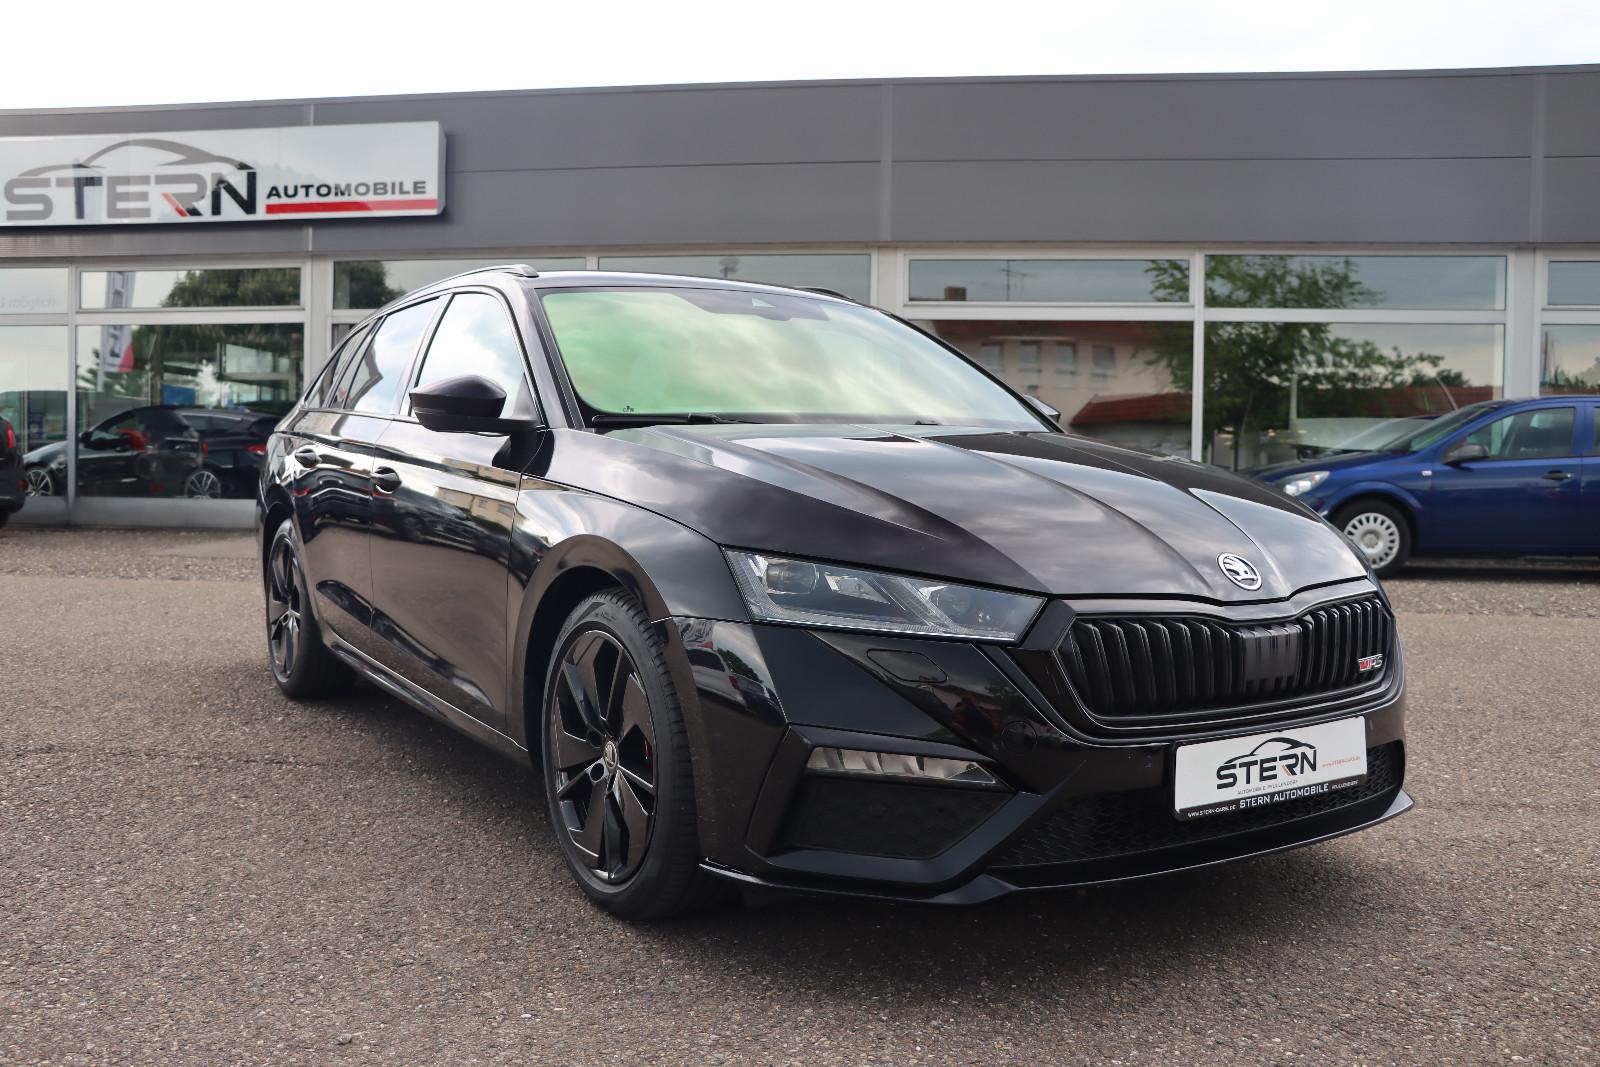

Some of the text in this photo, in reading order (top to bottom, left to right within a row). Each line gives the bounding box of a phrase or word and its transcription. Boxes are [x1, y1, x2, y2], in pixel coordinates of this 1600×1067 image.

[4, 171, 427, 221] STERN AUTOMOBILE
[1216, 749, 1317, 790] STERN
[1239, 795, 1271, 809] STERN
[1273, 783, 1329, 802] AUTOMOBILE
